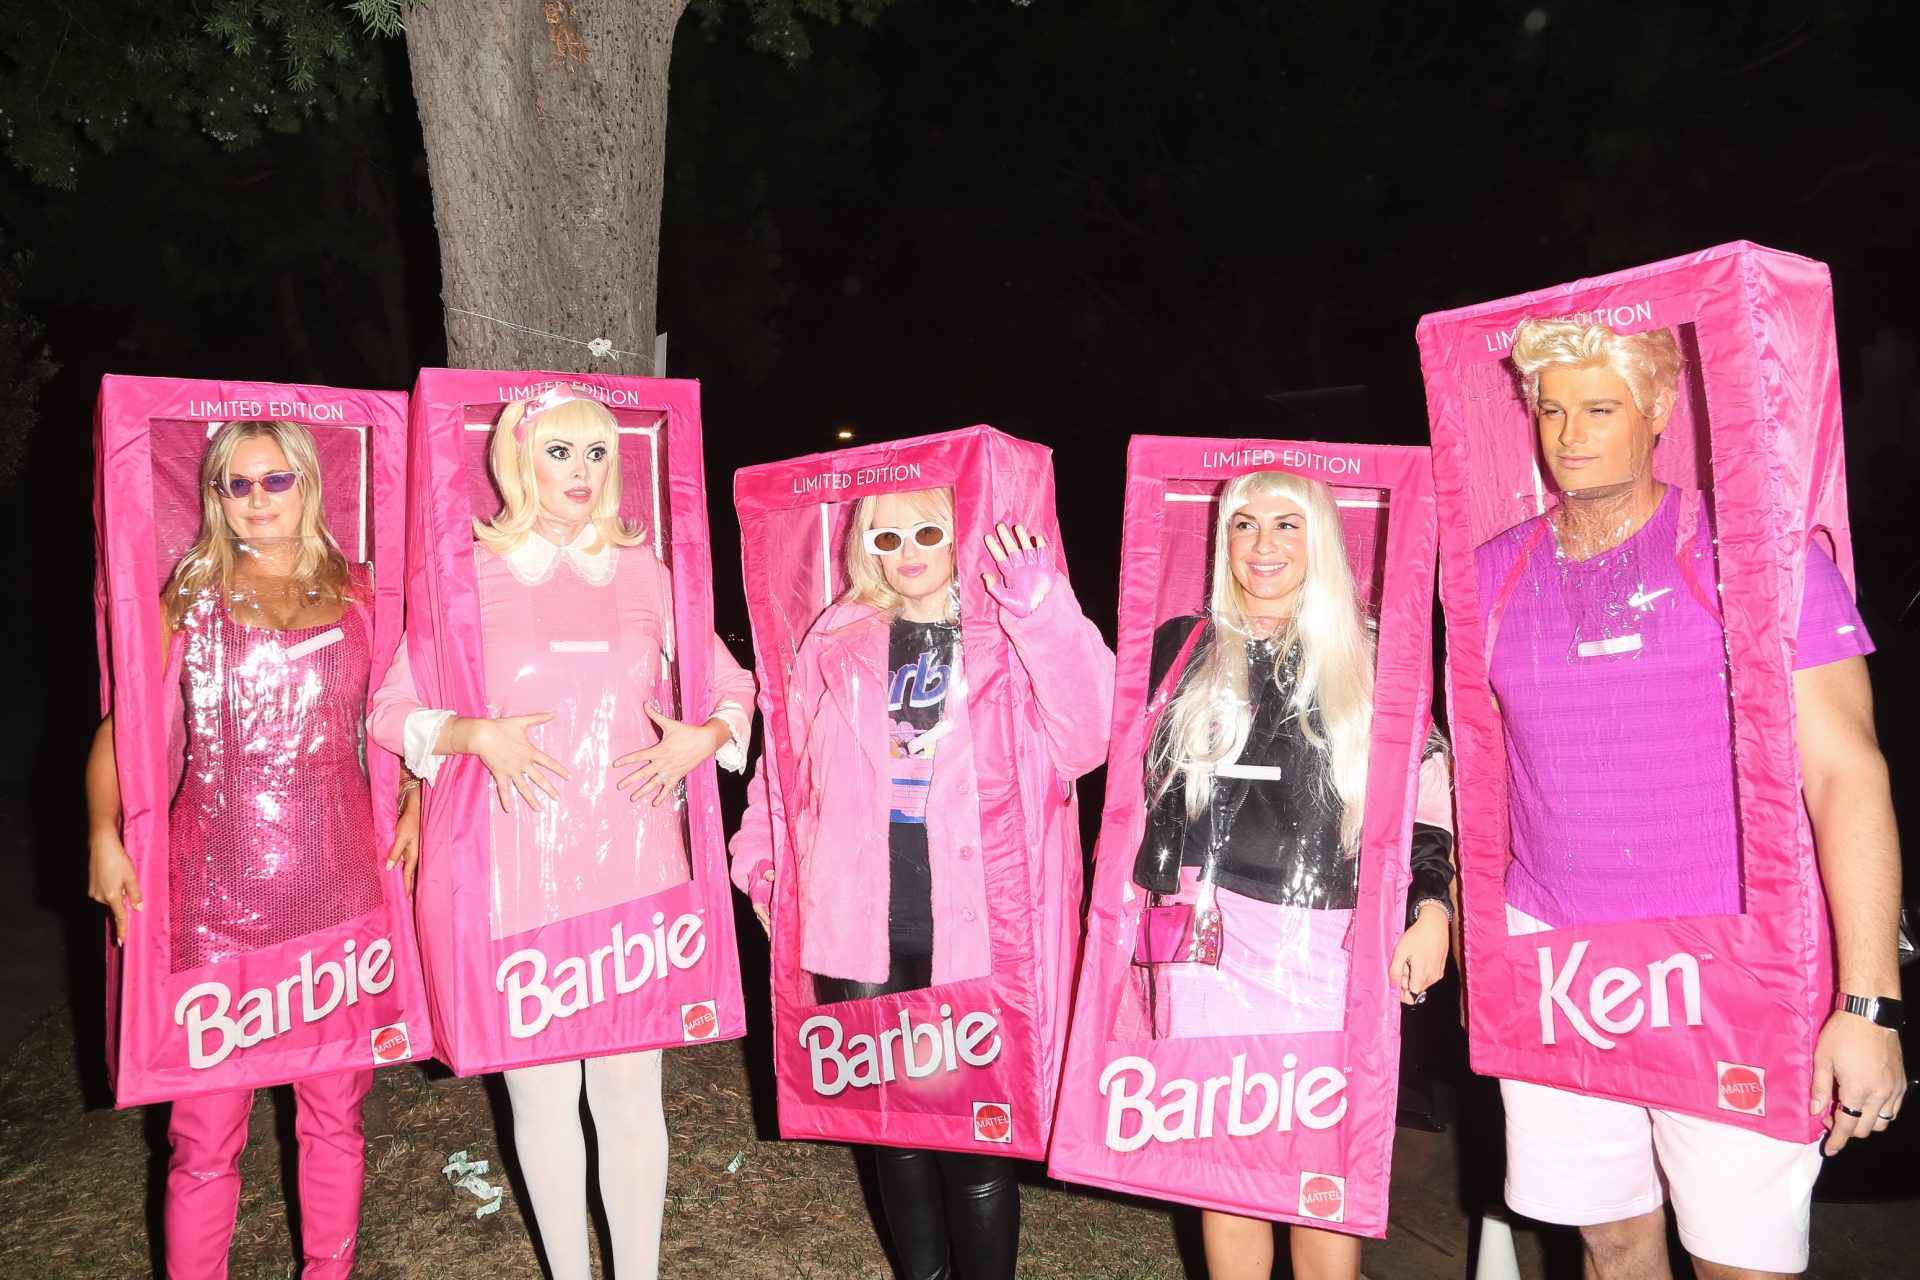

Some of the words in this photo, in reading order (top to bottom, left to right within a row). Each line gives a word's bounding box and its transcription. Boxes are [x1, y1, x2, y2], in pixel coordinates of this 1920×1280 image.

[189, 400, 262, 417] LIMITED
[269, 401, 344, 421] EDITION
[1203, 449, 1276, 468] LIMITED
[1283, 449, 1361, 475] EDITION
[793, 473, 852, 494] LIMITED
[856, 463, 921, 486] EDITION
[495, 911, 706, 1039] Barbie
[173, 938, 395, 1070] Barbie
[1536, 939, 1704, 1050] Ken
[684, 1012, 716, 1032] MATTEL
[374, 1033, 408, 1055] MATTEL
[798, 1003, 1002, 1096] Barbie
[1098, 1052, 1348, 1152] Barbie
[976, 1115, 1010, 1130] MATTEL
[1302, 1190, 1342, 1205] MATTEL
